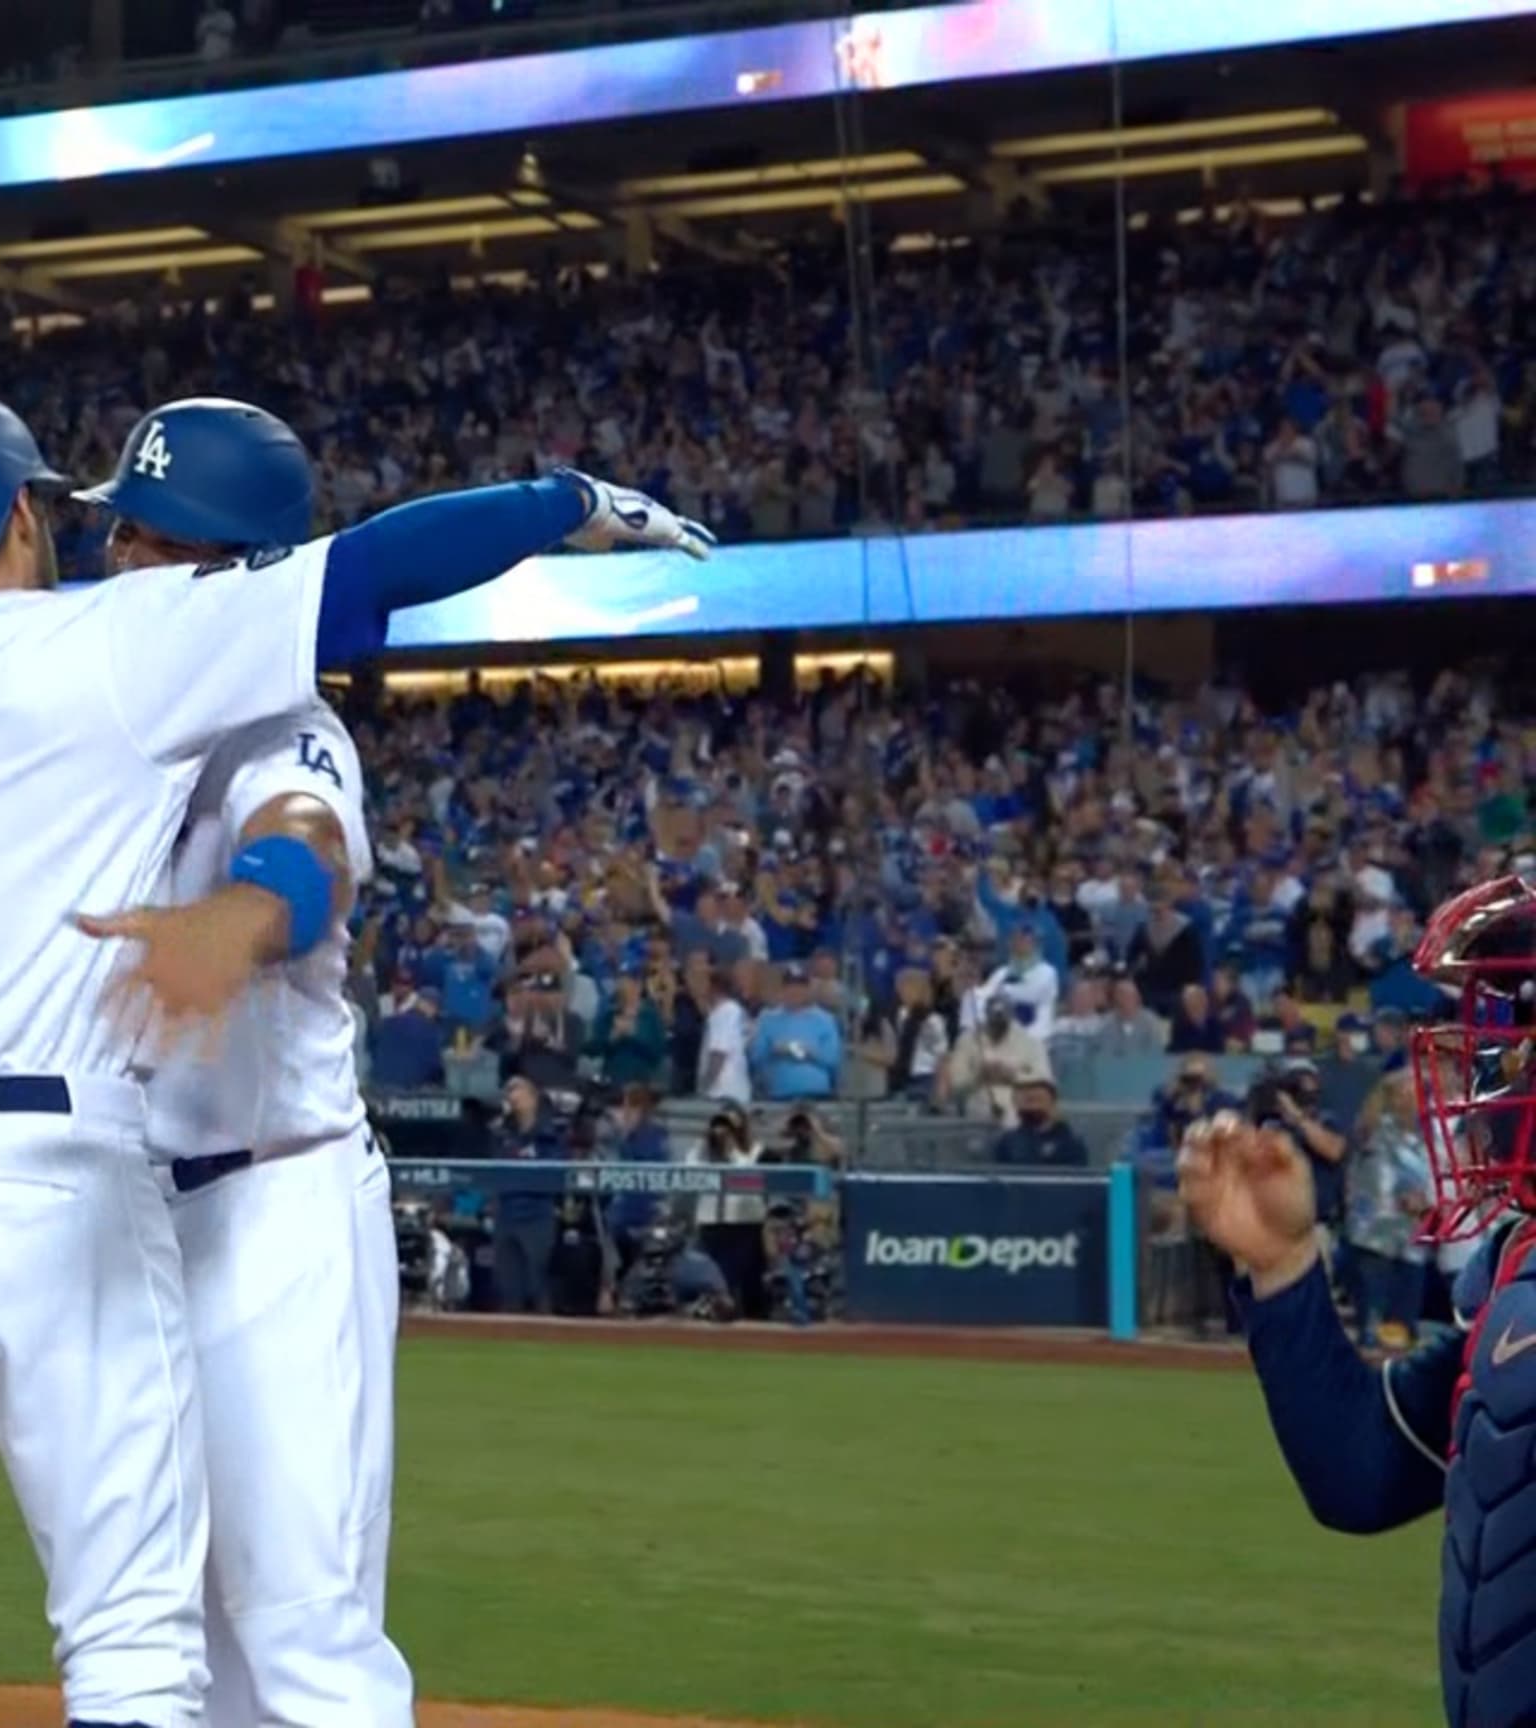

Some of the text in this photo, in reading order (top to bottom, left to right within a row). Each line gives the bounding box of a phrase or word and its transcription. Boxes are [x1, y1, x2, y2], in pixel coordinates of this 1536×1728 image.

[133, 420, 173, 479] LA
[295, 732, 343, 791] LA
[598, 1169, 722, 1192] POSTSEASON
[865, 1230, 1080, 1275] loanDepot
